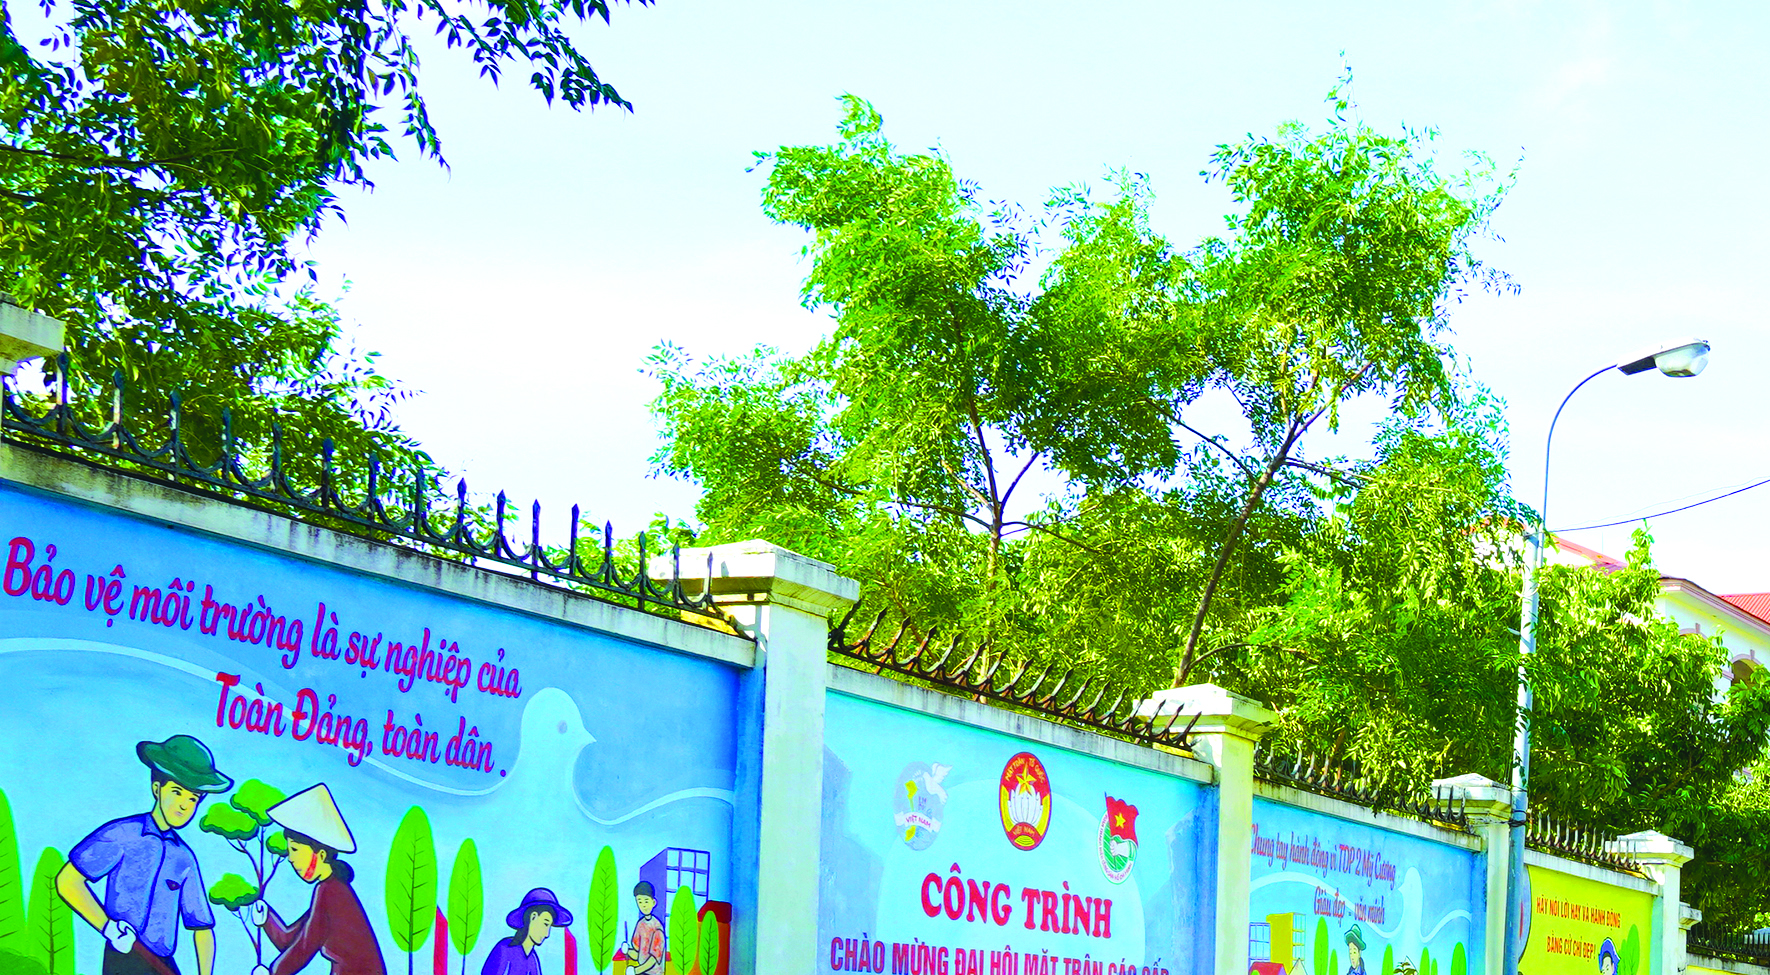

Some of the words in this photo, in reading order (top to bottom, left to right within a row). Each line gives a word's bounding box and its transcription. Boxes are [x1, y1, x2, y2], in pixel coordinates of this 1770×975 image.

[3, 537, 75, 605] Bảo
[85, 564, 126, 627] vệ
[129, 577, 194, 630] môi
[200, 584, 303, 669] trường
[311, 602, 341, 660] là
[345, 632, 382, 679] sự
[384, 627, 471, 703] nghiệp
[477, 648, 522, 698] của
[216, 671, 286, 737] Toàn
[291, 688, 373, 767] Đảng,
[382, 709, 441, 764] toàn
[1276, 833, 1288, 870] tay
[1290, 831, 1309, 865] hành
[1311, 836, 1329, 878] động
[1355, 847, 1361, 876] 2
[1362, 849, 1374, 887] Mỹ
[921, 862, 1012, 926] CÔNG
[1021, 881, 1112, 938] TRÌNH
[1571, 903, 1581, 920] HAY
[831, 932, 885, 973] CHÀO
